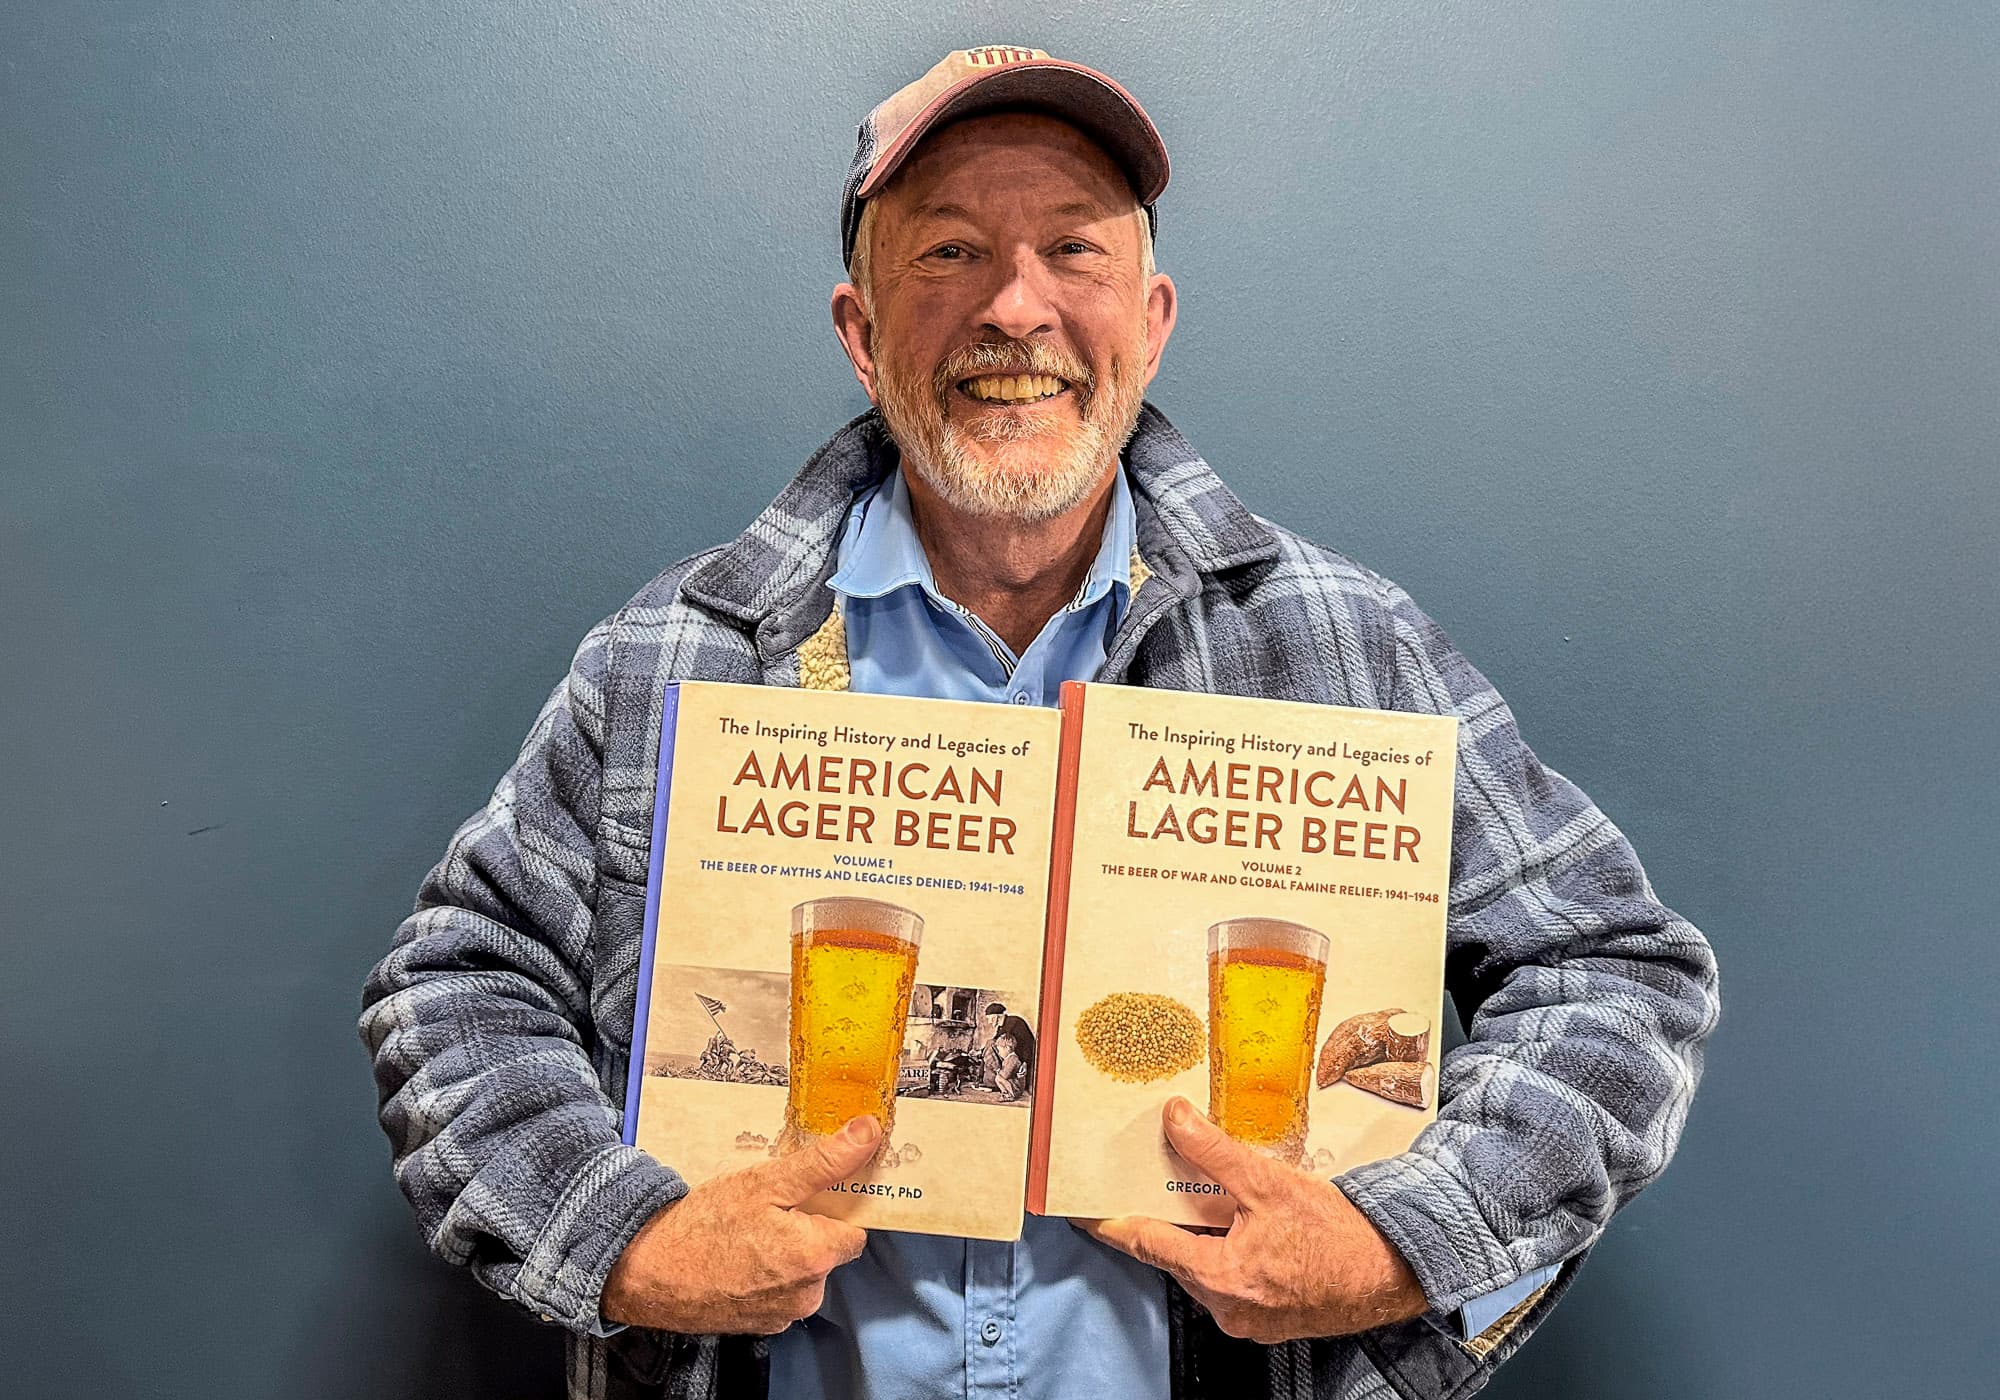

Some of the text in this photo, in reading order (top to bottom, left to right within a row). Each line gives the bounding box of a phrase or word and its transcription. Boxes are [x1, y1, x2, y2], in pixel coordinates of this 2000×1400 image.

[720, 718, 1030, 757] The Inspiring History and Legacies of
[1129, 723, 1433, 766] The Inspiring History and Legacies of
[733, 750, 1003, 807] AMERICAN
[1143, 756, 1407, 815] AMERICAN
[717, 796, 1016, 855] LAGER BEER
[1128, 801, 1421, 863] LAGER BEER
[700, 860, 1024, 895] THE BEER OF MYTHS AND LEGACIES DENIED: 1941-1948
[834, 855, 893, 870] VOLUME 1
[1242, 861, 1302, 876] VOLUME 2
[1102, 864, 1439, 903] THE BEER OF WAR AND GLOBAL FAMINE RELIEF: 1941-1948
[827, 1182, 922, 1199] UL CASEY, PhD
